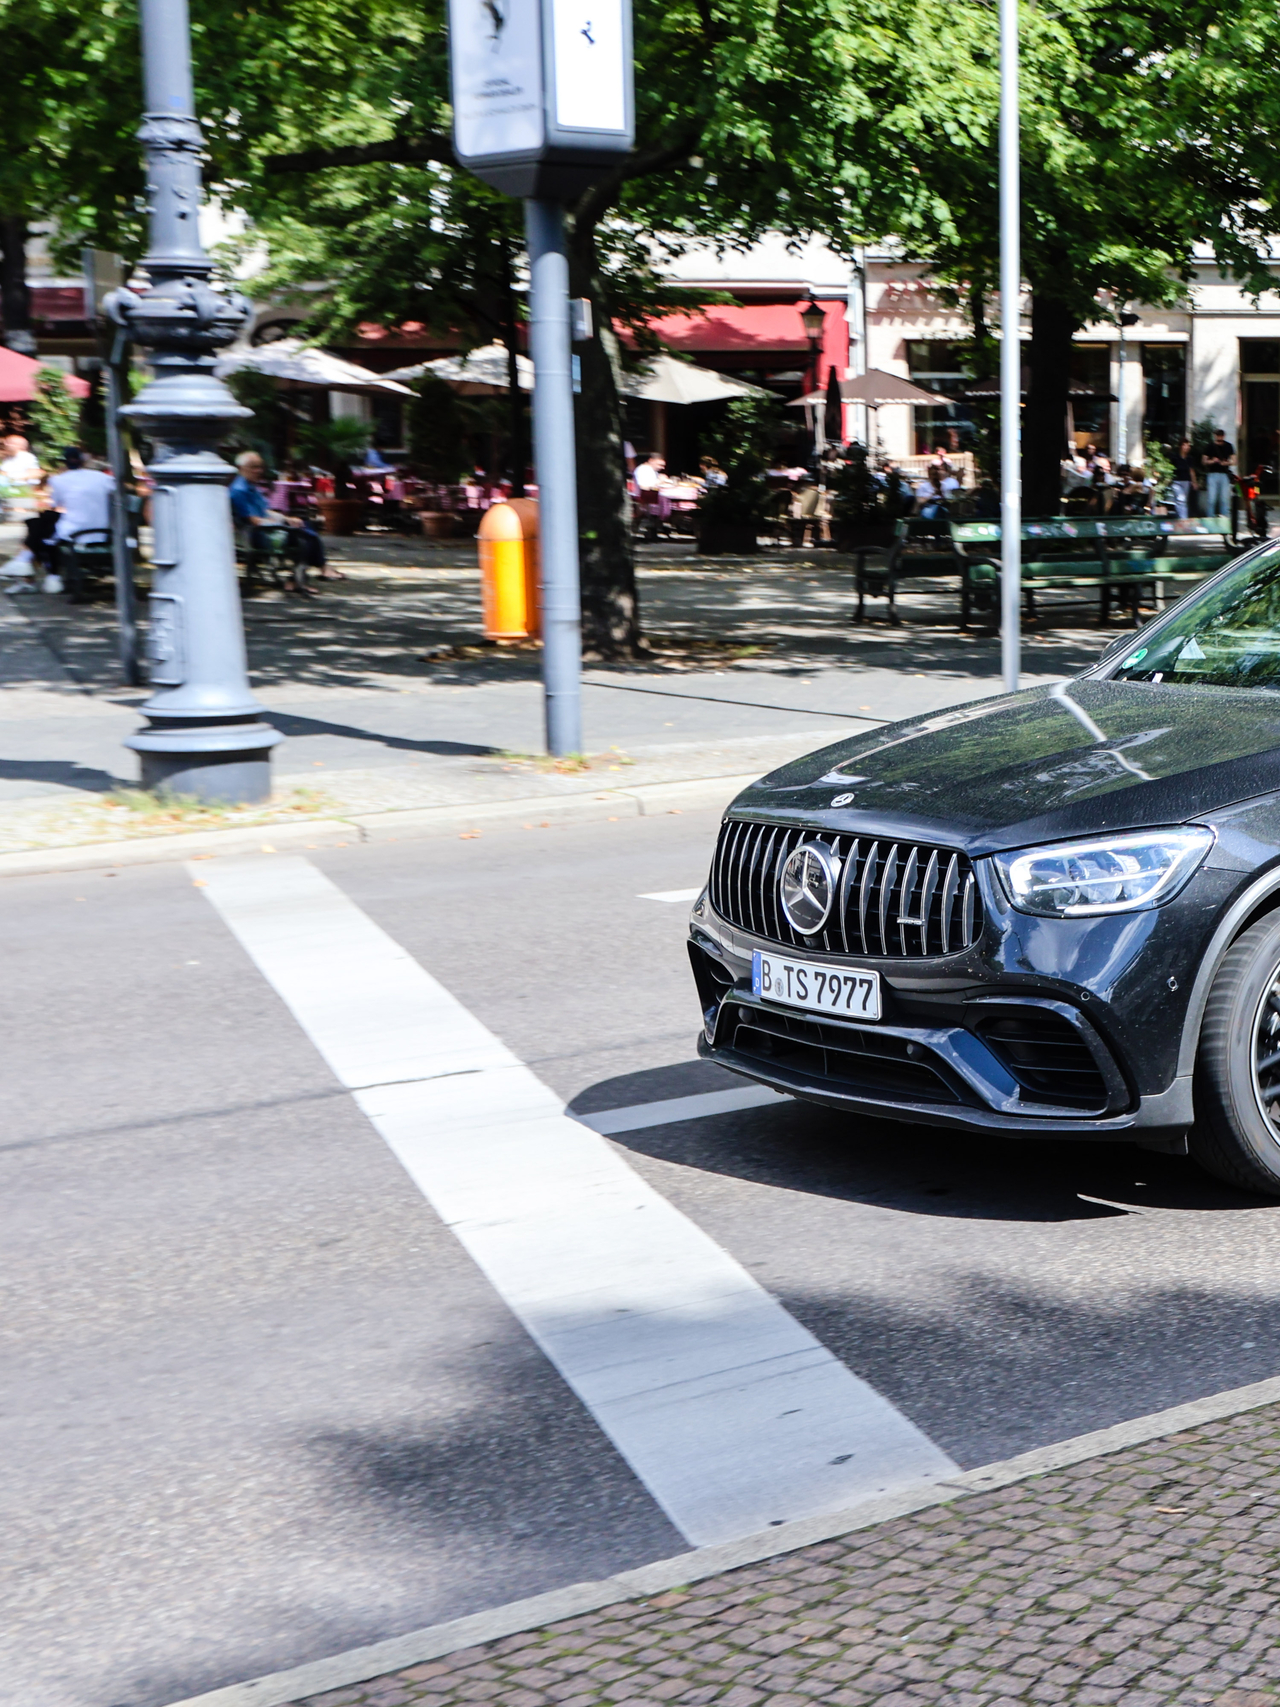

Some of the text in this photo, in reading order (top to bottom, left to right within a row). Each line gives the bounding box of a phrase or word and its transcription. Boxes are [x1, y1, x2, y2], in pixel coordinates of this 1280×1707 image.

[762, 959, 873, 1012] B TS 7977
